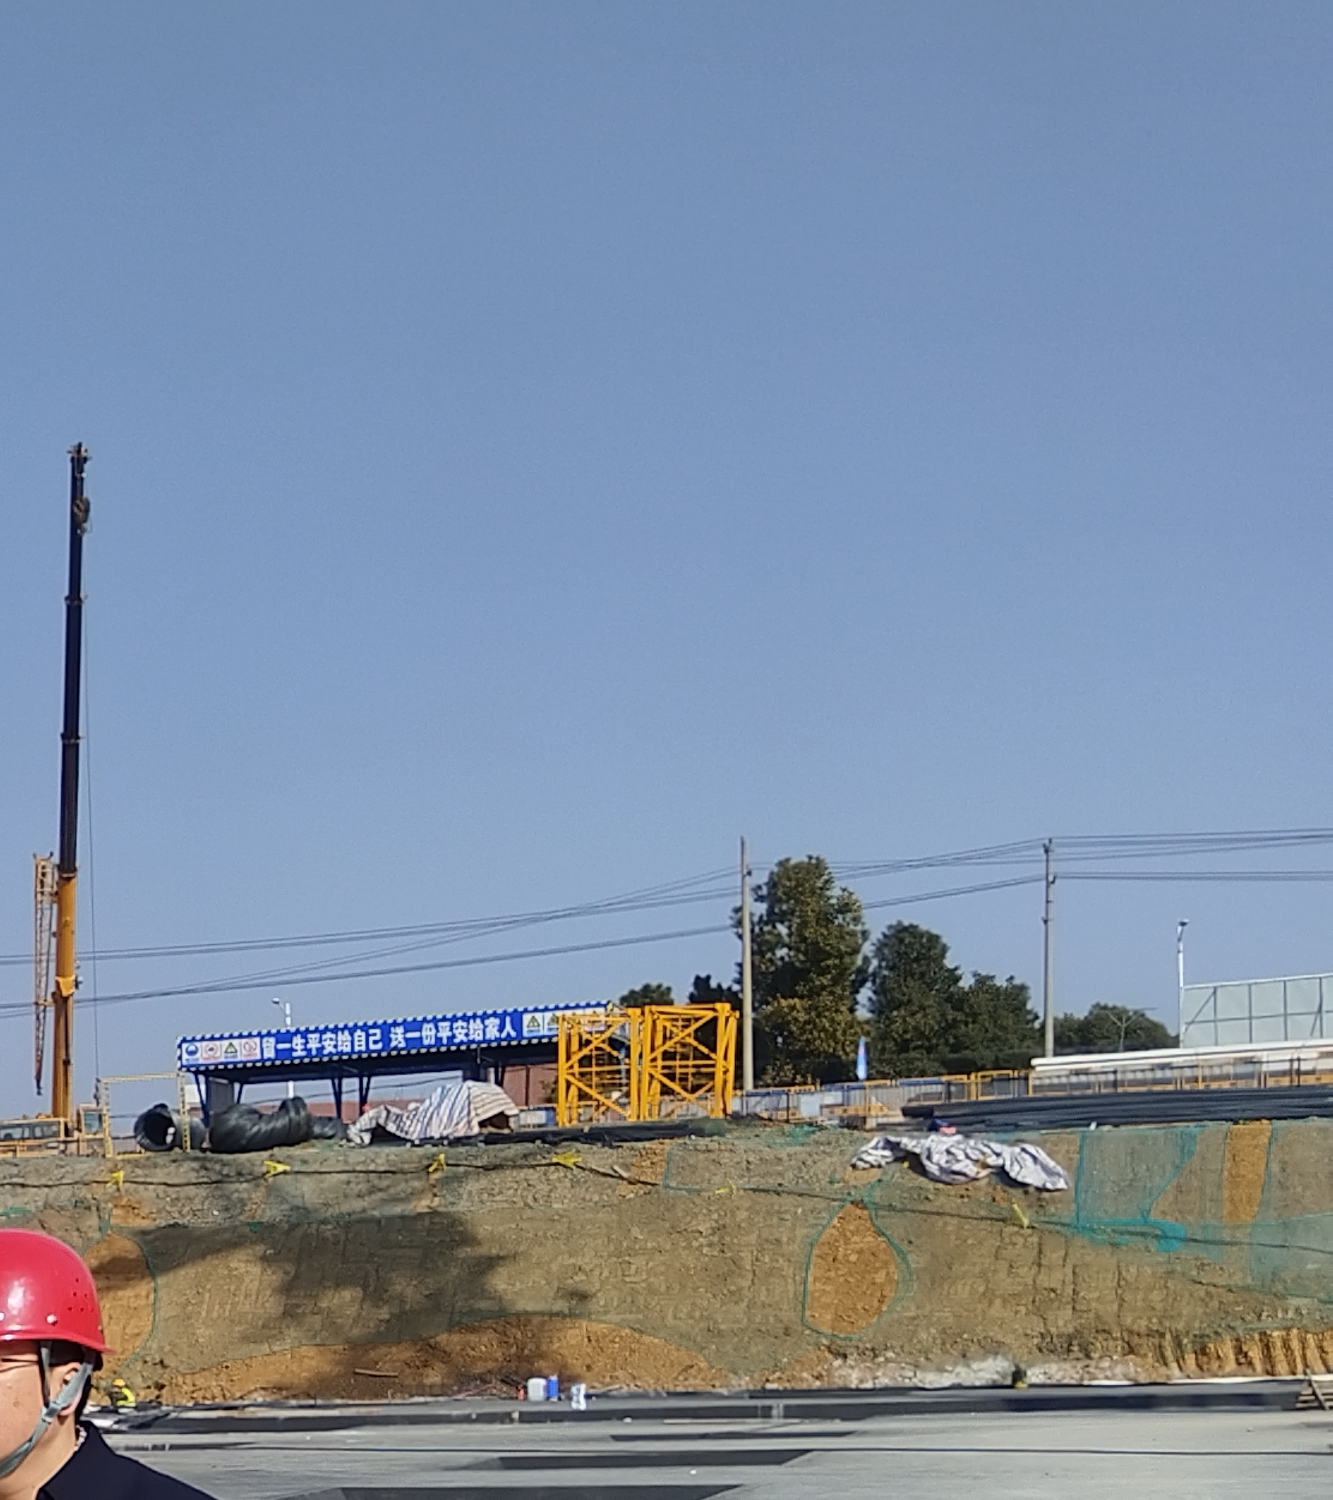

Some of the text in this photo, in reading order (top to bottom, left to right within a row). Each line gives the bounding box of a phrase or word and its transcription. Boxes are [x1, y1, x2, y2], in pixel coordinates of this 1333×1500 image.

[262, 1015, 517, 1059] 留一生平安给自己 送一份平安给家人
